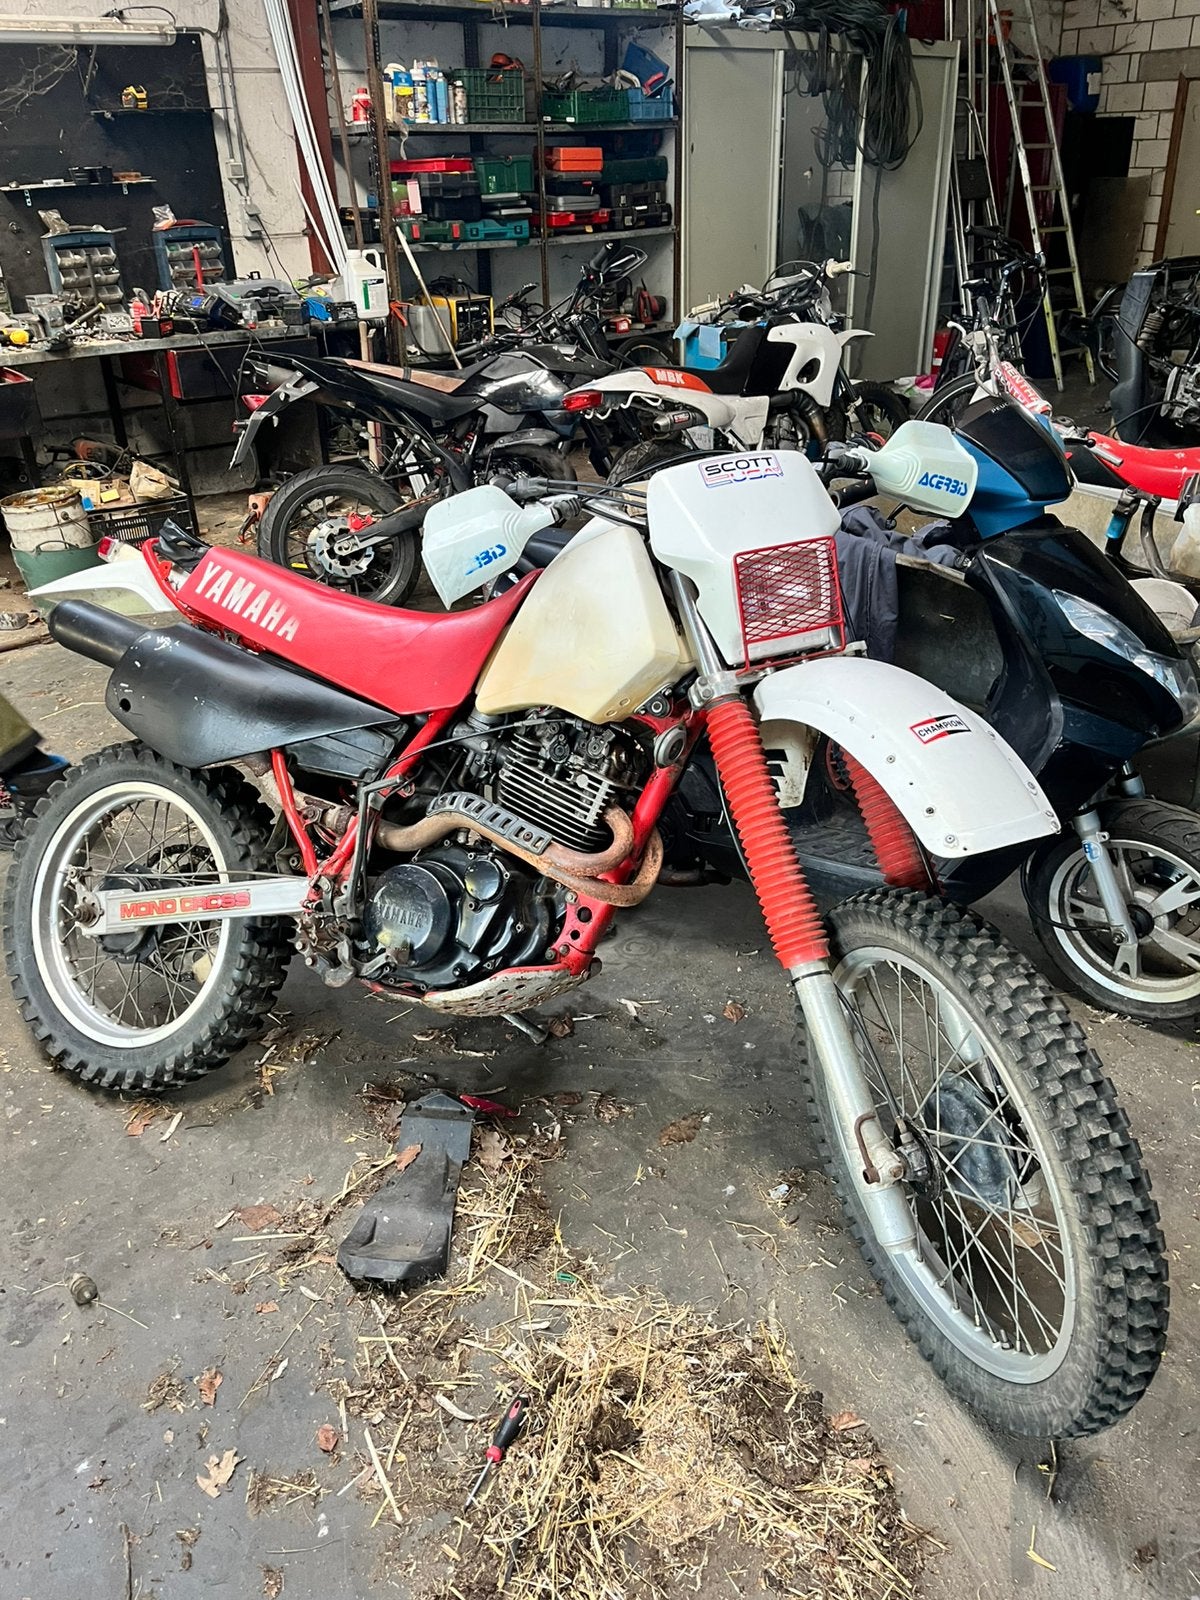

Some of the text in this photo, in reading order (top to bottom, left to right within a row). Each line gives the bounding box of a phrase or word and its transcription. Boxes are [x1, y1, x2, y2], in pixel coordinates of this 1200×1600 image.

[655, 369, 685, 384] MBK
[705, 457, 772, 476] SCOTT
[918, 472, 968, 496] ACERBIS
[195, 560, 300, 642] YAMAHA
[918, 720, 963, 737] CHAMPION
[120, 892, 250, 918] MONO CROSS
[377, 901, 425, 928] YAMAHA
